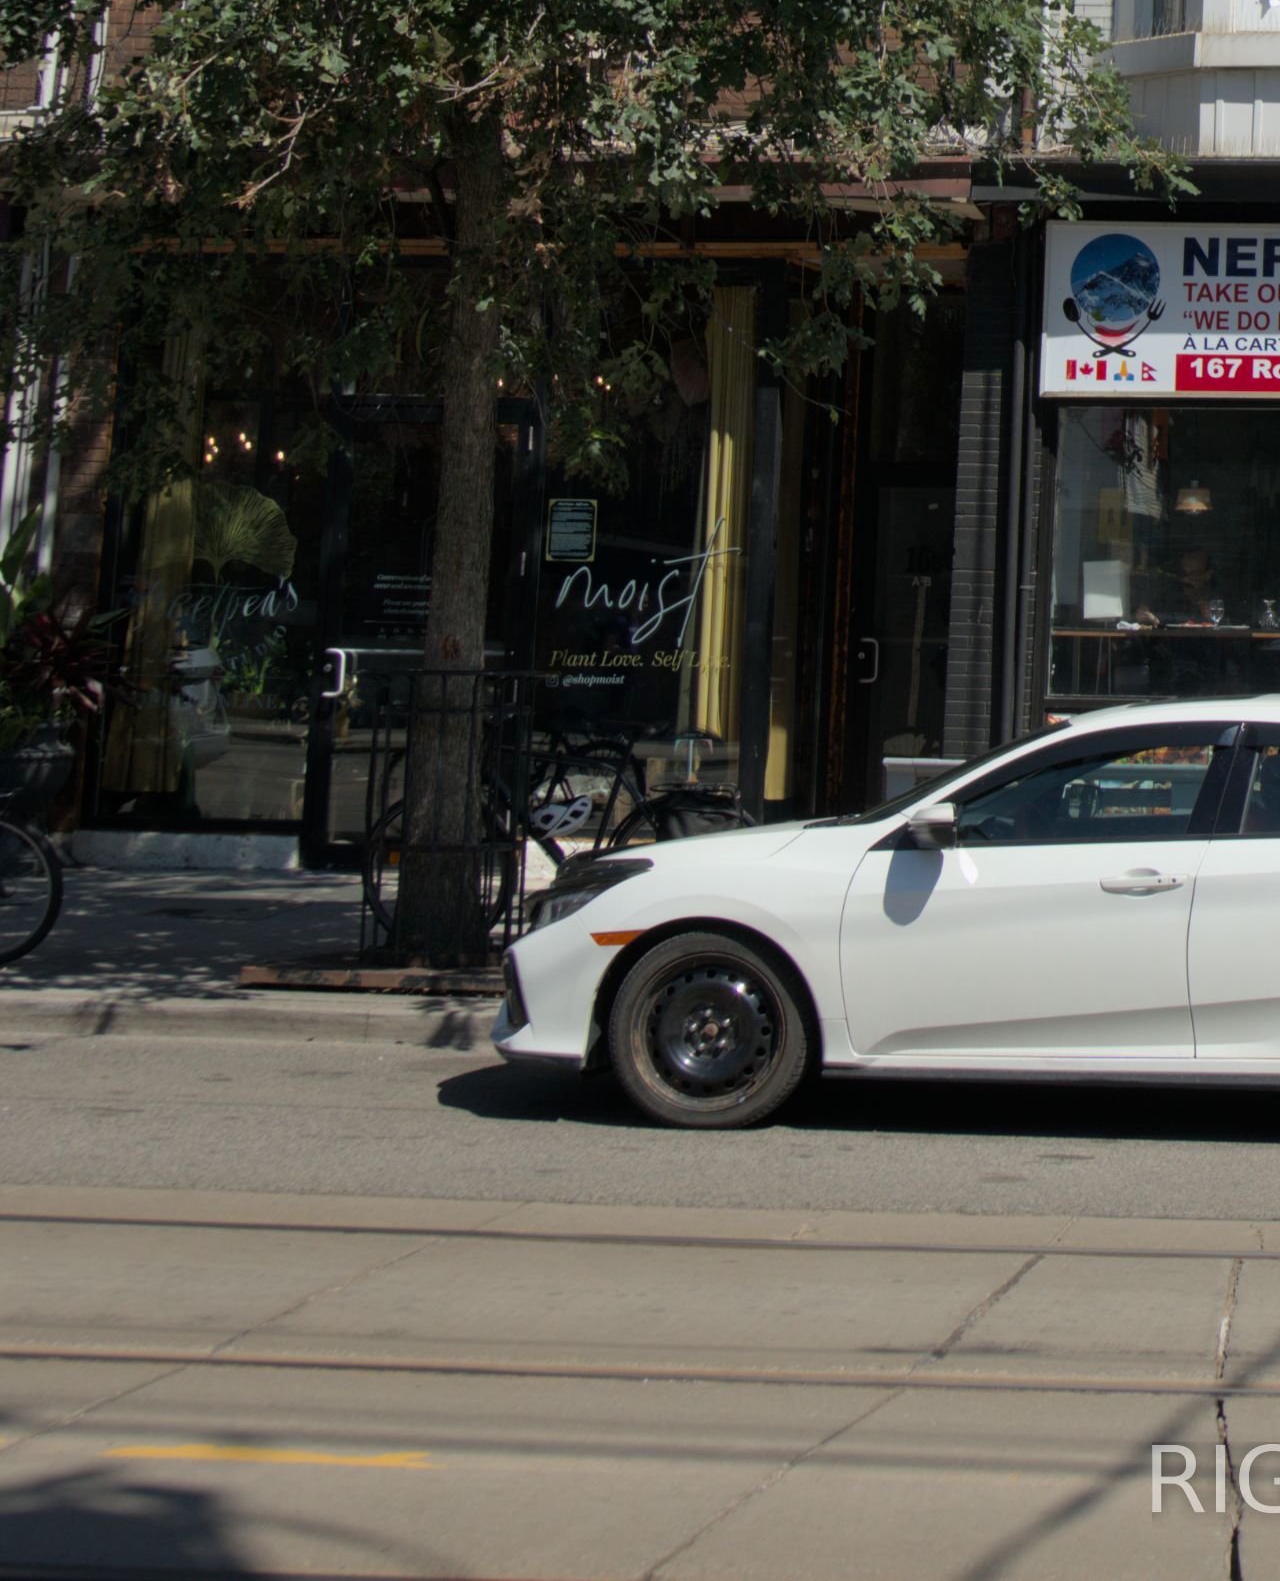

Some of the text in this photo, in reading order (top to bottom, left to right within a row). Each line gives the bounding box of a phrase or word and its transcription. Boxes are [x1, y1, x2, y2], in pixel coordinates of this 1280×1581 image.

[1183, 282, 1249, 302] TAKE
[1237, 311, 1271, 332] DO
[1183, 333, 1197, 351] À
[1203, 336, 1230, 352] LA
[1190, 358, 1243, 379] 167
[556, 516, 743, 649] moist
[549, 649, 597, 667] Plant
[600, 649, 644, 668] Love.
[651, 649, 684, 671] Self
[562, 673, 625, 688] @shopmoist
